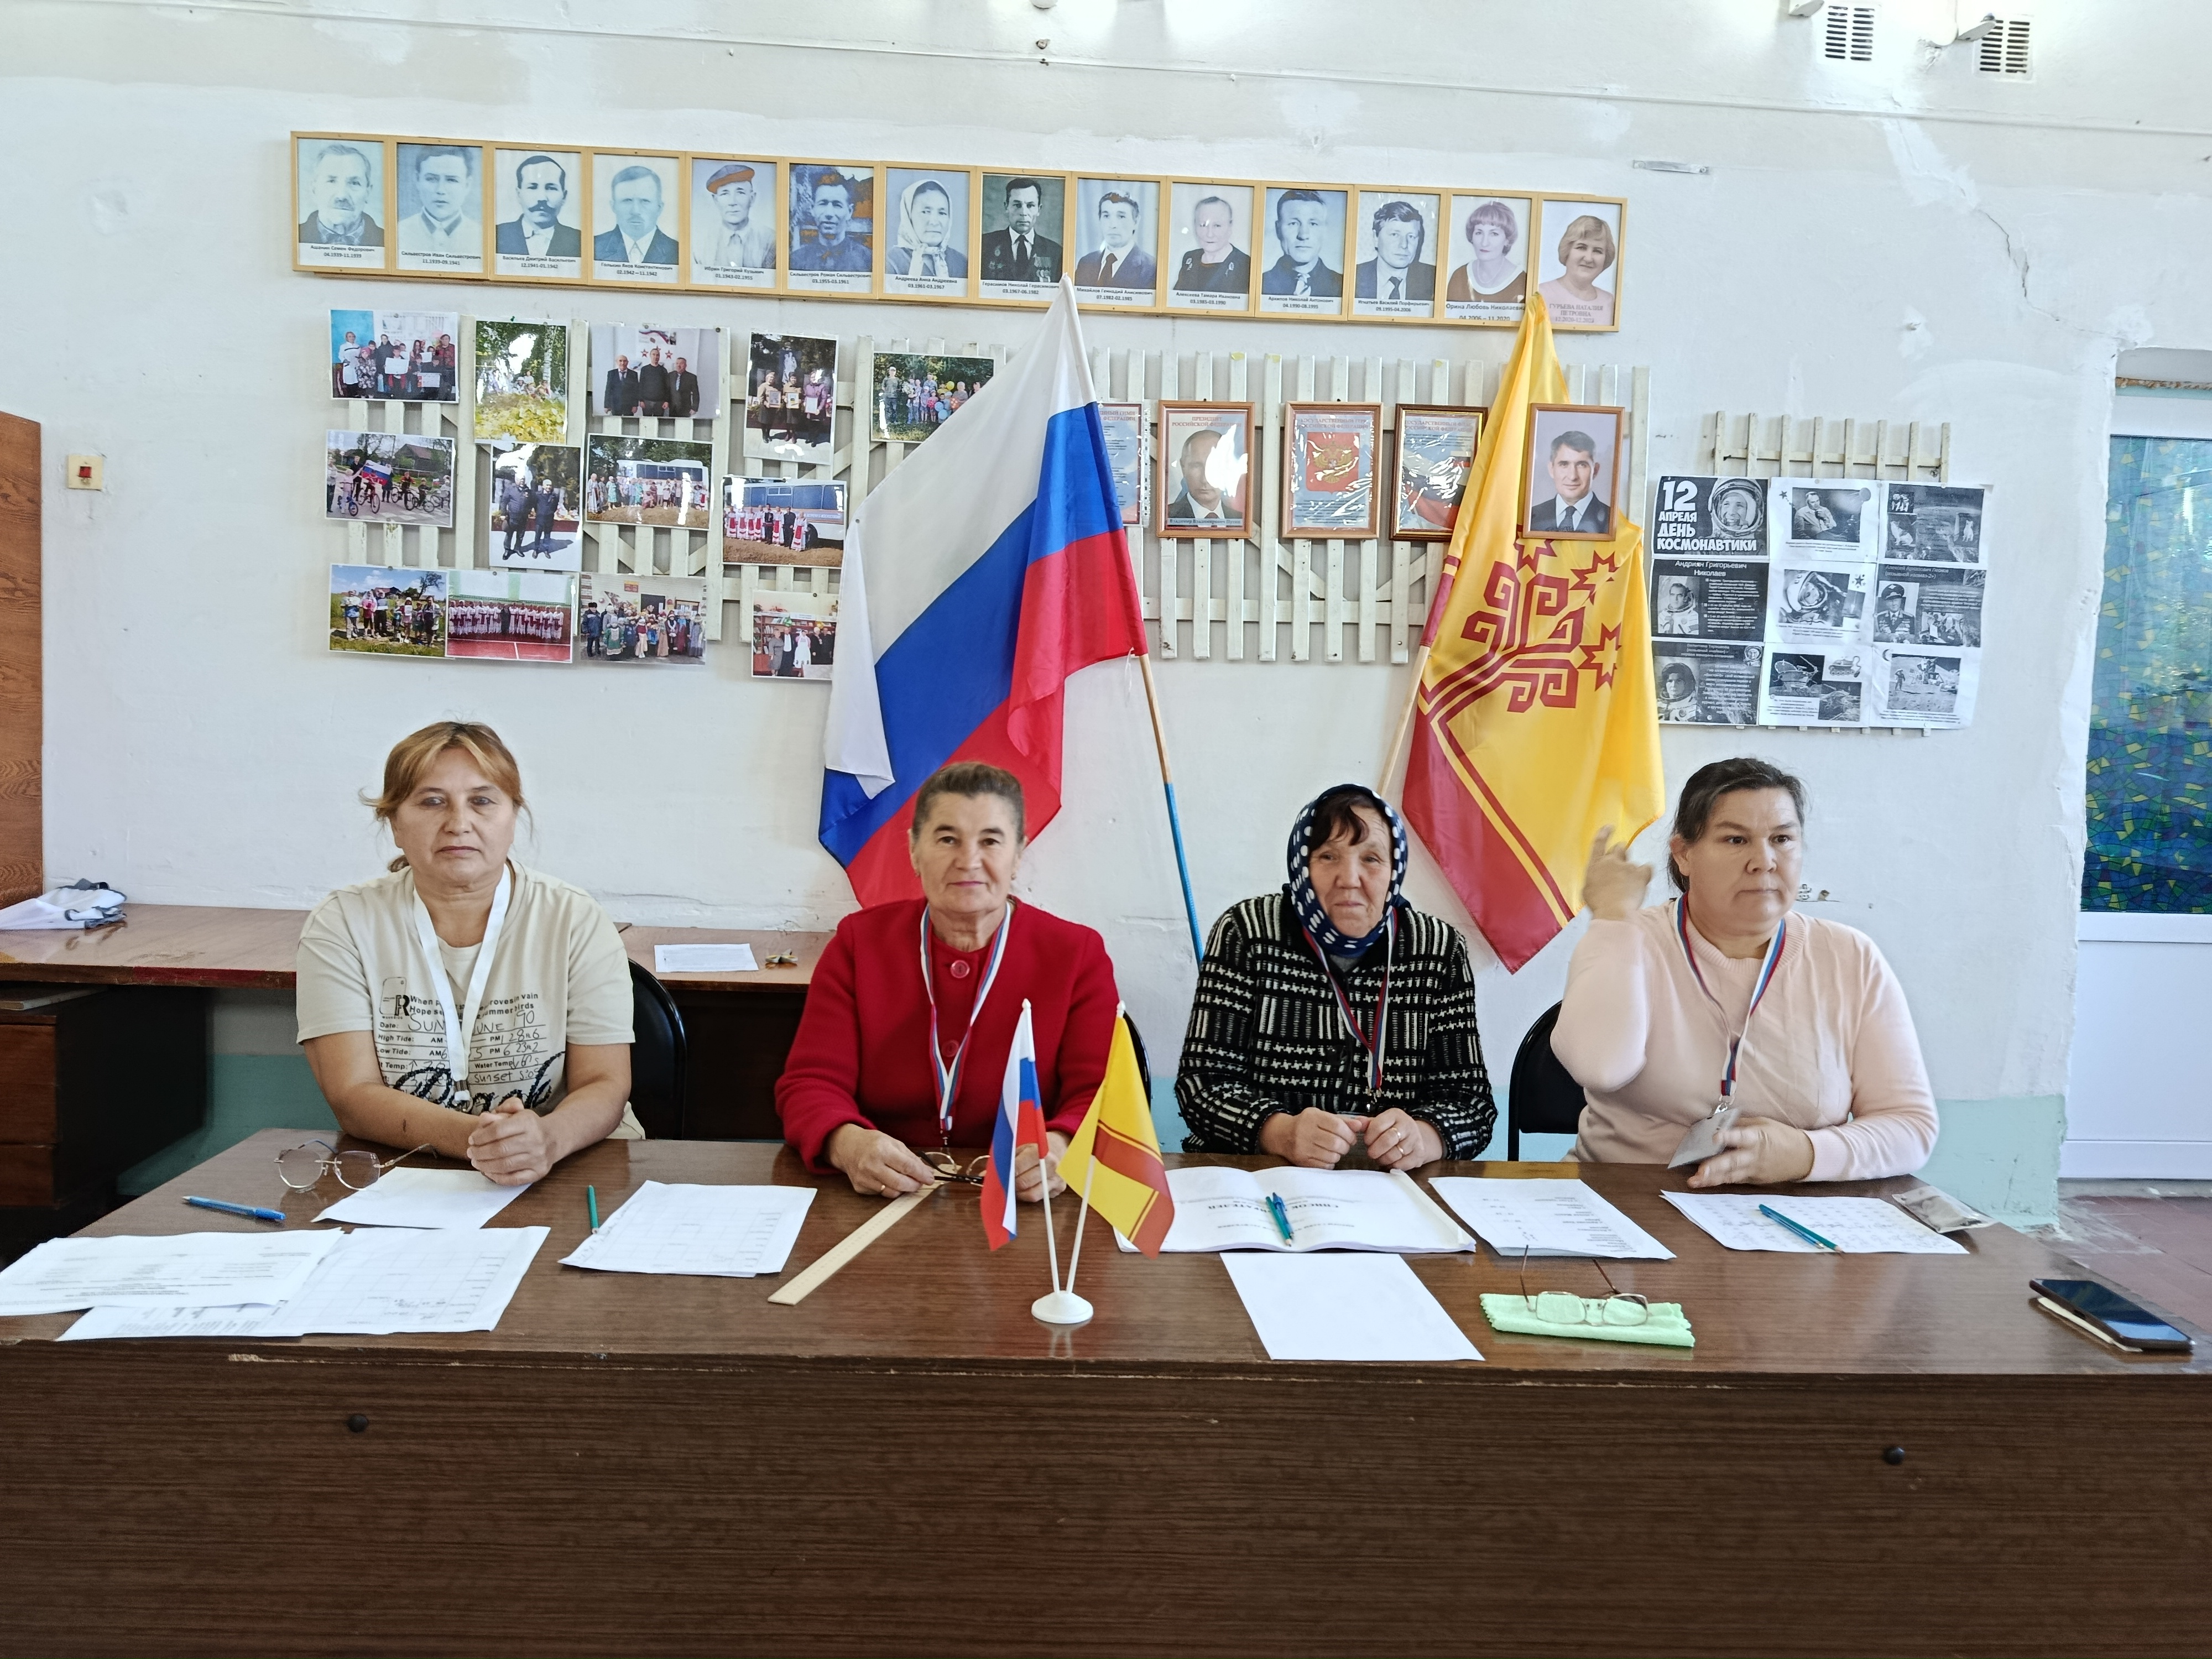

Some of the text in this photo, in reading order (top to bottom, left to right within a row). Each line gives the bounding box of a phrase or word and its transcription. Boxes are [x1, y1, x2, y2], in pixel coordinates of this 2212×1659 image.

[1663, 481, 1698, 511] 12
[1658, 511, 1697, 522] АПРЕЛЯ
[1657, 523, 1695, 538] ДЕНЬ
[1657, 538, 1757, 551] КОСМОНАВТИКИ
[410, 995, 433, 1005] When
[410, 1006, 431, 1015] Hope
[474, 1072, 513, 1083] Sunset
